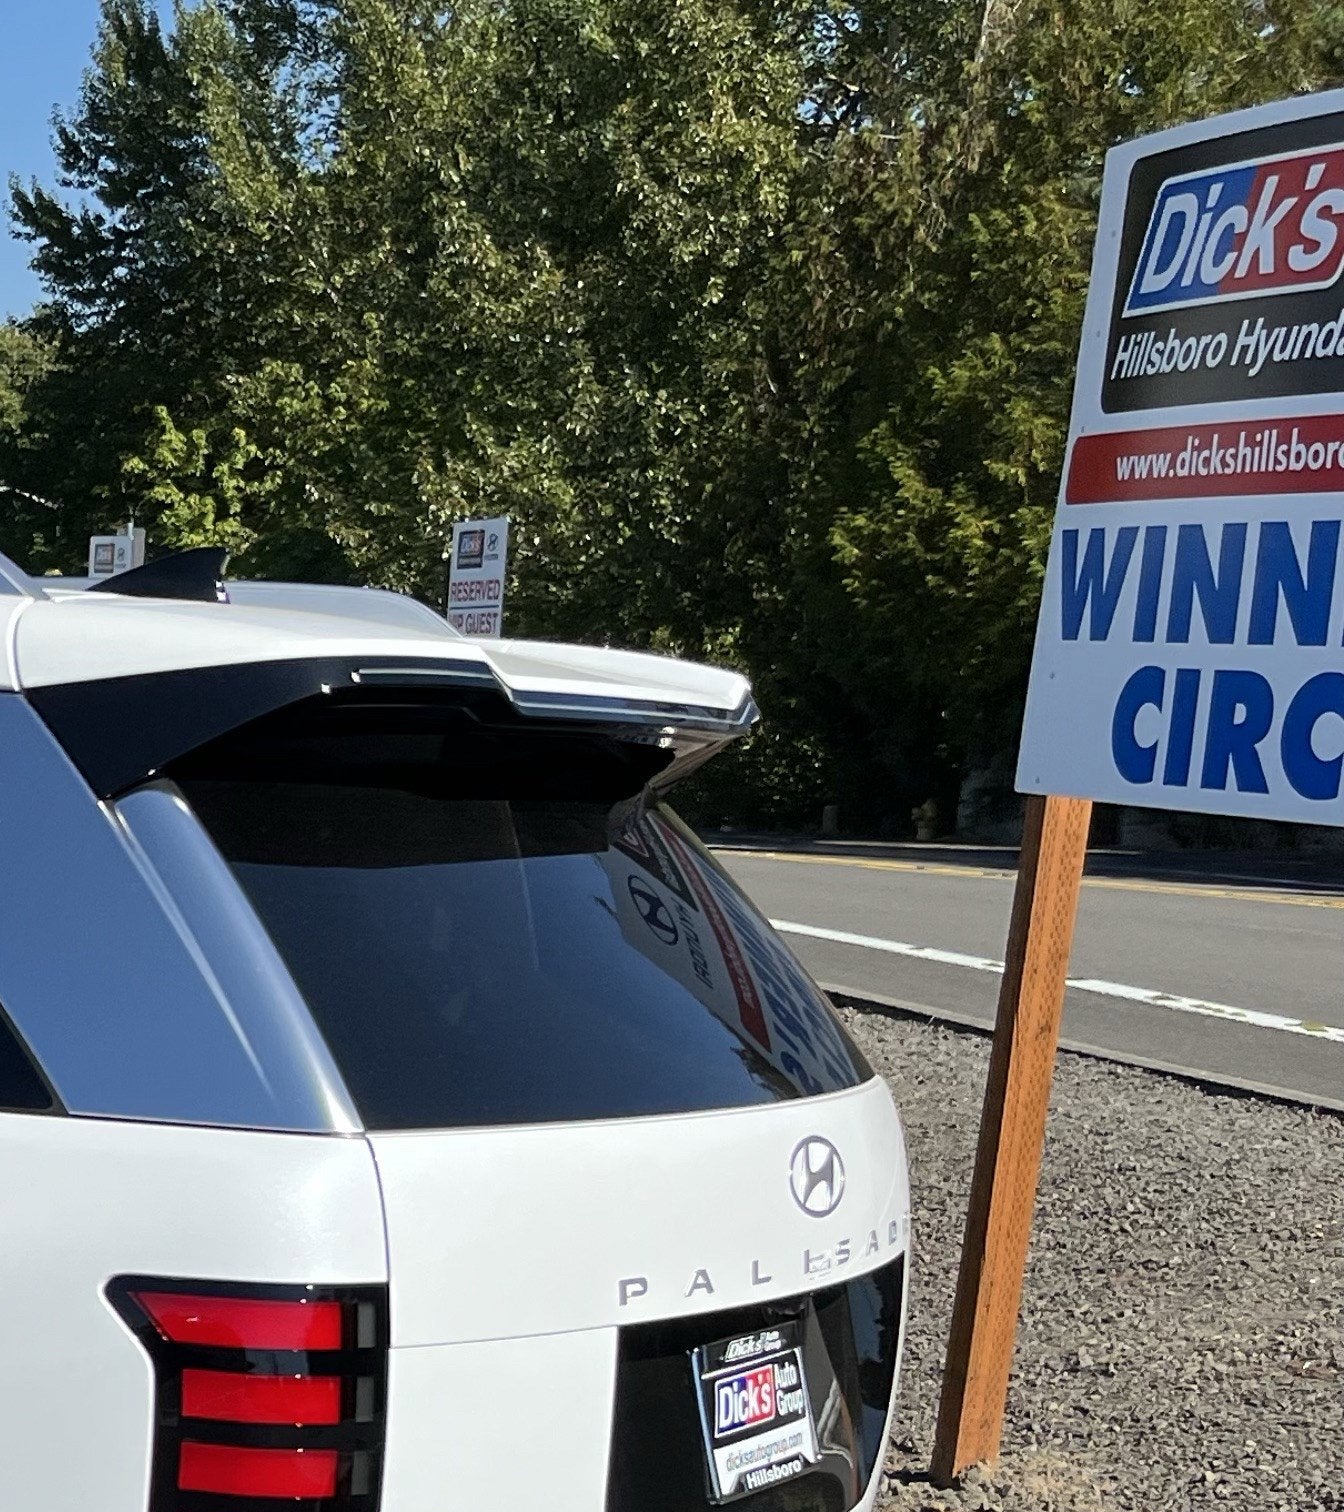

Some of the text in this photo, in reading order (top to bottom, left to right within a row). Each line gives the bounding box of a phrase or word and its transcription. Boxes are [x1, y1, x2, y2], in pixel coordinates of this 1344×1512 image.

[1140, 163, 1344, 294] Dick's
[1111, 328, 1228, 380] Hillsboro
[451, 579, 501, 601] RESERVED
[1062, 520, 1344, 647] WINN
[465, 612, 498, 634] GUEST
[1112, 665, 1344, 801] CIRC
[618, 1214, 909, 1306] PALISAD
[719, 1372, 771, 1428] Dick's
[774, 1362, 798, 1389] Auto
[776, 1388, 804, 1416] Group
[746, 1459, 802, 1490] Hillsboro
